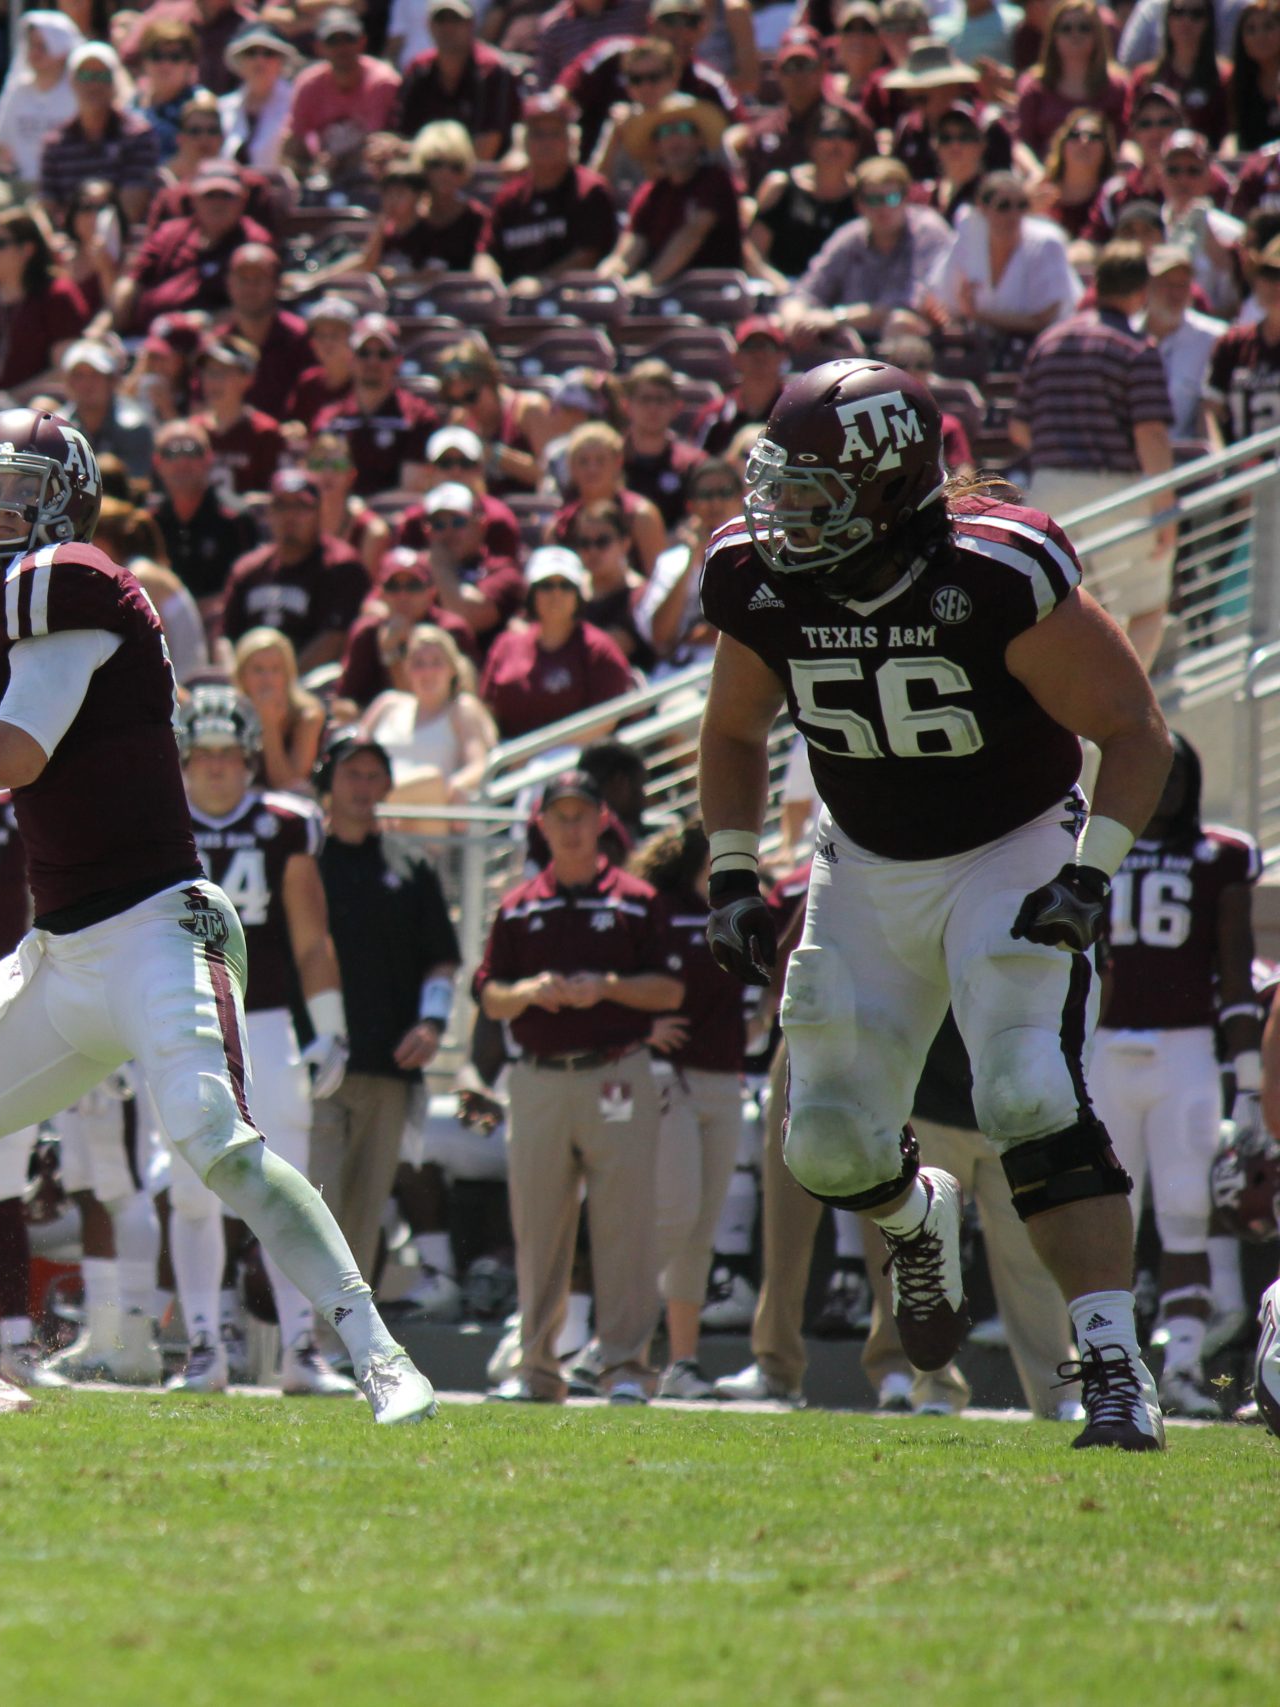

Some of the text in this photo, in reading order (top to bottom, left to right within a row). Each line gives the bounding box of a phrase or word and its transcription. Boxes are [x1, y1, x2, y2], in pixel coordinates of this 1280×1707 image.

[748, 599, 785, 611] adidas
[933, 589, 970, 621] SEC
[801, 625, 937, 648] TEXAS A&M
[787, 656, 984, 759] 56
[1110, 871, 1193, 949] 16
